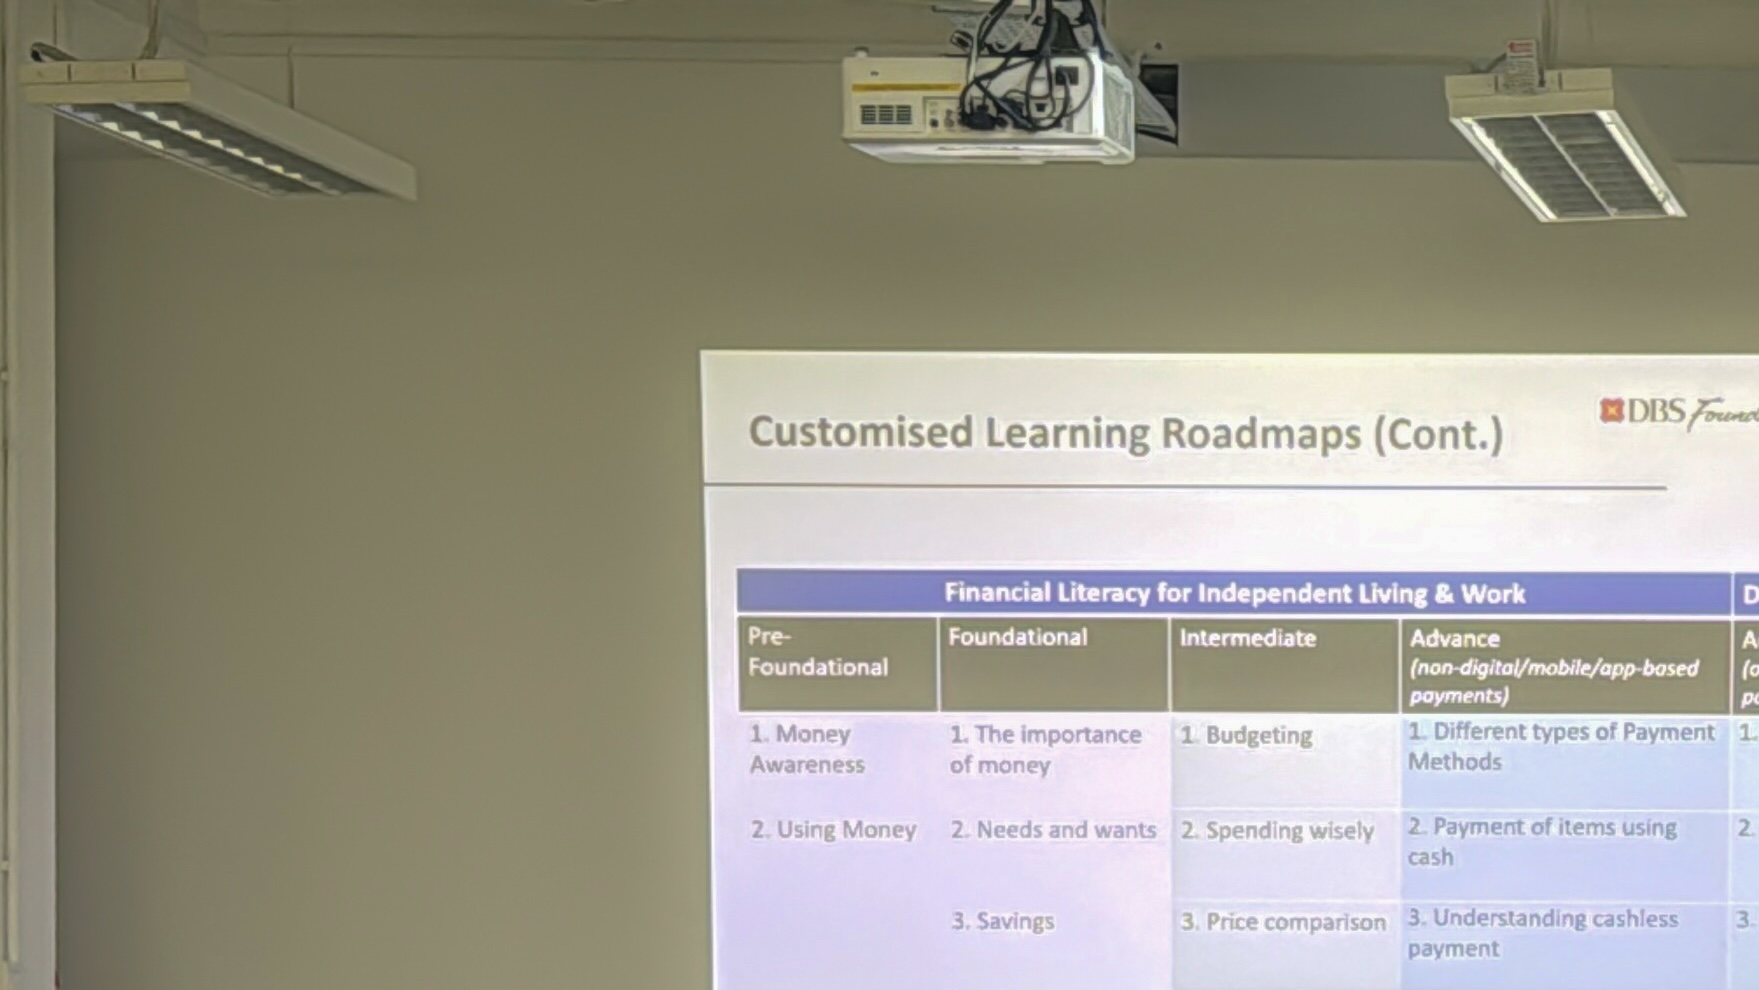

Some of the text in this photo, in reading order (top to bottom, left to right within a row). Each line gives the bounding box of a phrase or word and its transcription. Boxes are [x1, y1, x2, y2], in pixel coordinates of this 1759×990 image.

[1629, 398, 1686, 425] DBS
[749, 414, 1503, 457] Customised Learning Roadmaps (Cont.)
[945, 581, 1527, 607] Financial Literacy for Independent Living & Work
[748, 626, 792, 648] Pre-
[948, 627, 1088, 648] Foundational
[1179, 628, 1317, 648] Intermediate
[1410, 629, 1500, 649] Advance
[748, 657, 888, 678] Foundational
[1409, 658, 1700, 680] (non-digital/mobile/app-based
[1410, 687, 1510, 708] payments)
[750, 724, 851, 749] 1. Money
[951, 724, 1143, 750] 1. The importance
[1206, 725, 1314, 750] Budgeting
[1408, 722, 1717, 748] 1. Different types of Payment
[1738, 723, 1759, 743] 1.
[749, 755, 866, 775] Awareness
[949, 755, 1052, 779] of money
[1408, 751, 1503, 772] Methods
[751, 820, 918, 845] 2. Using Money
[951, 819, 1158, 841] 2. Needs and wants
[1181, 819, 1376, 845] 2. Spending wisely
[1408, 817, 1678, 843] 2. Payment of items using
[1737, 819, 1757, 840] 2.
[1408, 846, 1454, 867] cash
[952, 911, 1056, 936] 3. Savings
[1181, 912, 1387, 937] 3. Price comparison
[1408, 908, 1680, 933] 3. Understanding cashless
[1736, 911, 1757, 931] 3.
[1408, 939, 1501, 963] payment
